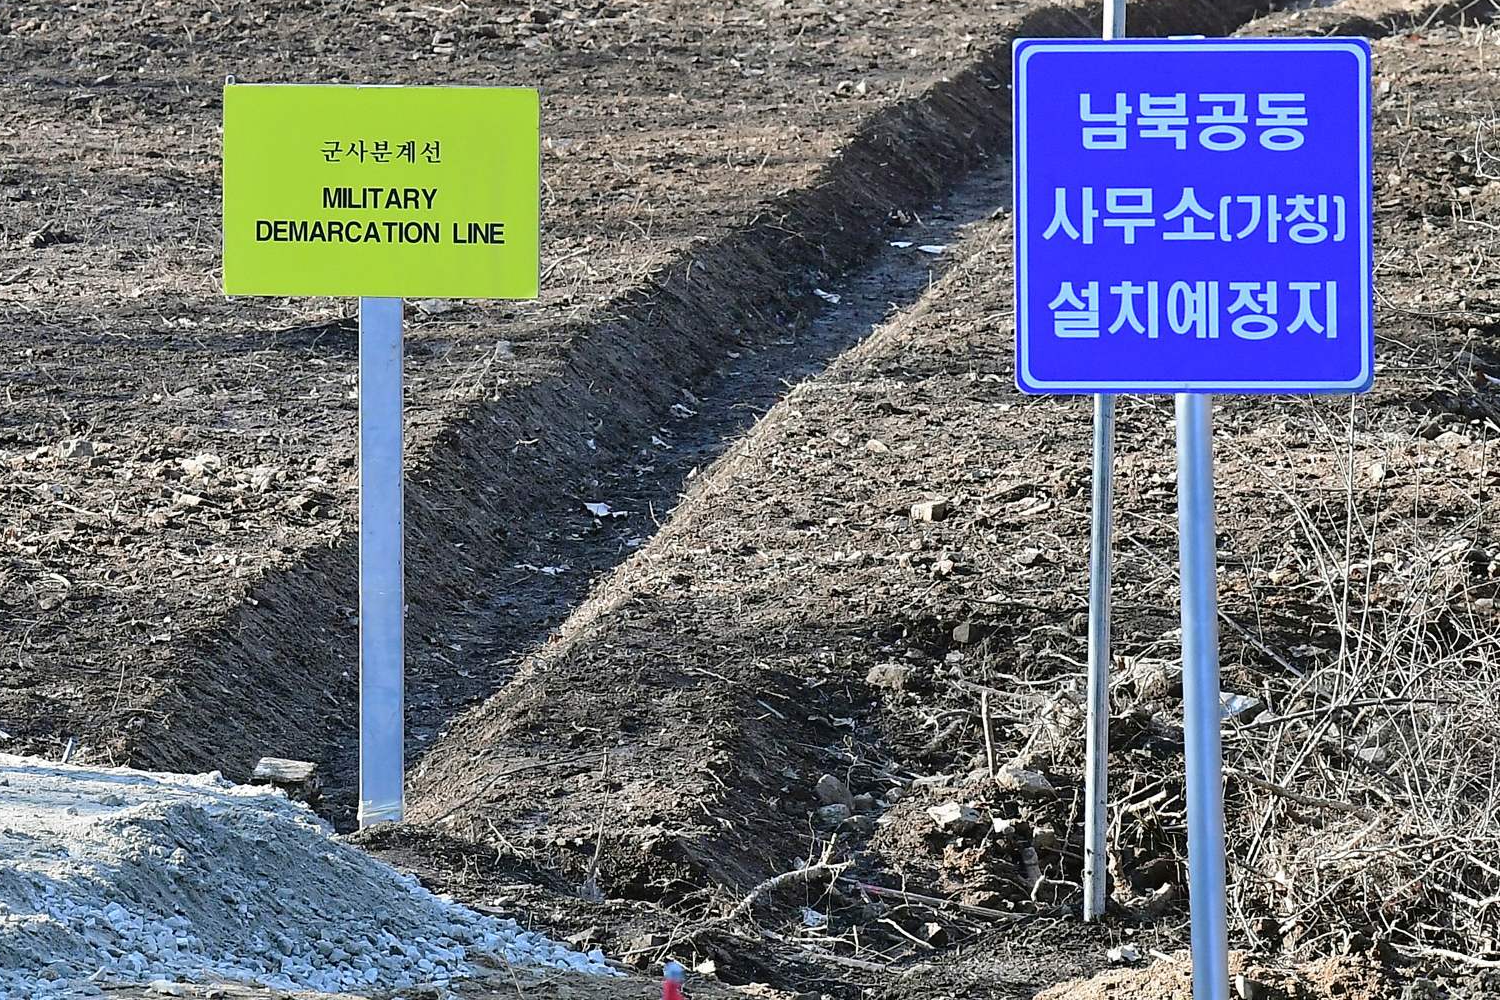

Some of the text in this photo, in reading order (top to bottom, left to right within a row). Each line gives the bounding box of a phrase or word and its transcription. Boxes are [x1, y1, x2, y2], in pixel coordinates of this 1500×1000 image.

[1079, 92, 1309, 152] 남북공동
[320, 139, 442, 164] 군사분계선
[323, 187, 438, 210] MILITARY
[1042, 186, 1346, 245] 사무소(가칭)
[256, 220, 505, 245] DEMARCATION LINE
[1047, 280, 1338, 341] 설치예정지
